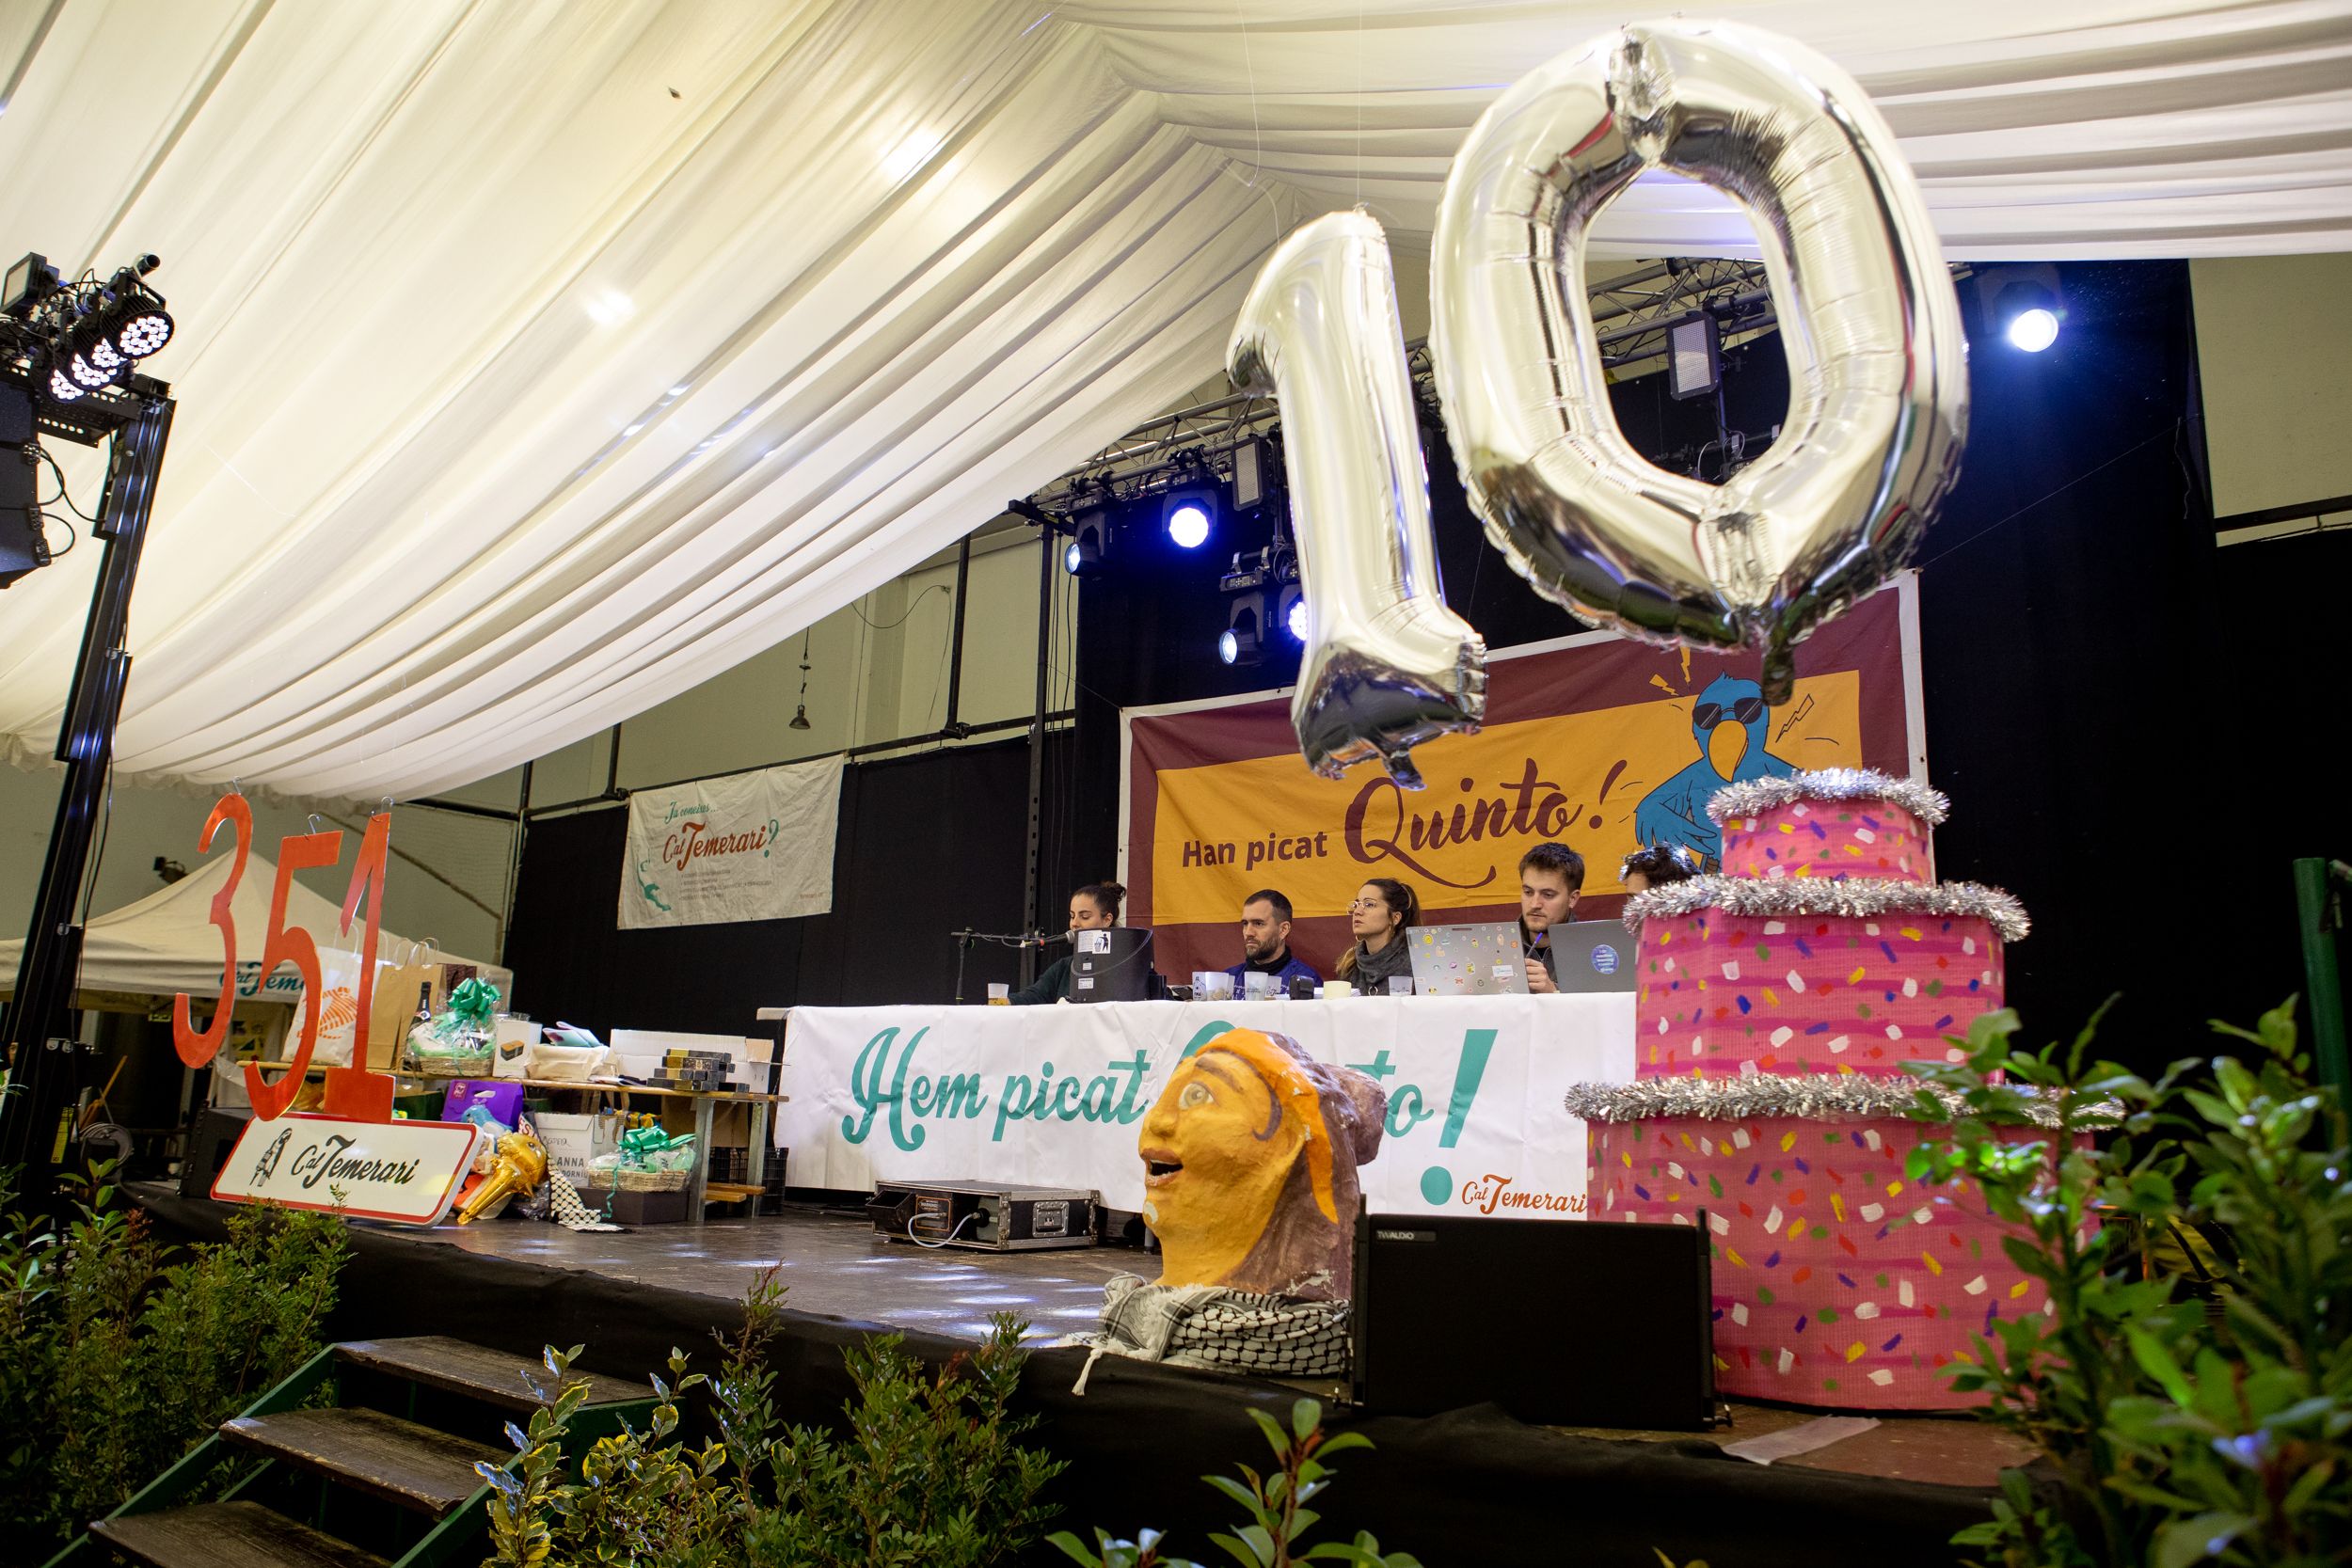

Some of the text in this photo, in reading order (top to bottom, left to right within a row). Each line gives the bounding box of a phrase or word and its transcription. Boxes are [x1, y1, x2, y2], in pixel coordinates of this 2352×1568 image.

[1182, 757, 1628, 889] Han picat Quinto!
[663, 834, 686, 863] Cal
[841, 1025, 988, 1152] Hem
[992, 1049, 1152, 1142] picat
[291, 1134, 420, 1189] Cal Temerari
[557, 1156, 584, 1167] ANNA
[1461, 1173, 1587, 1215] Cal Temerari
